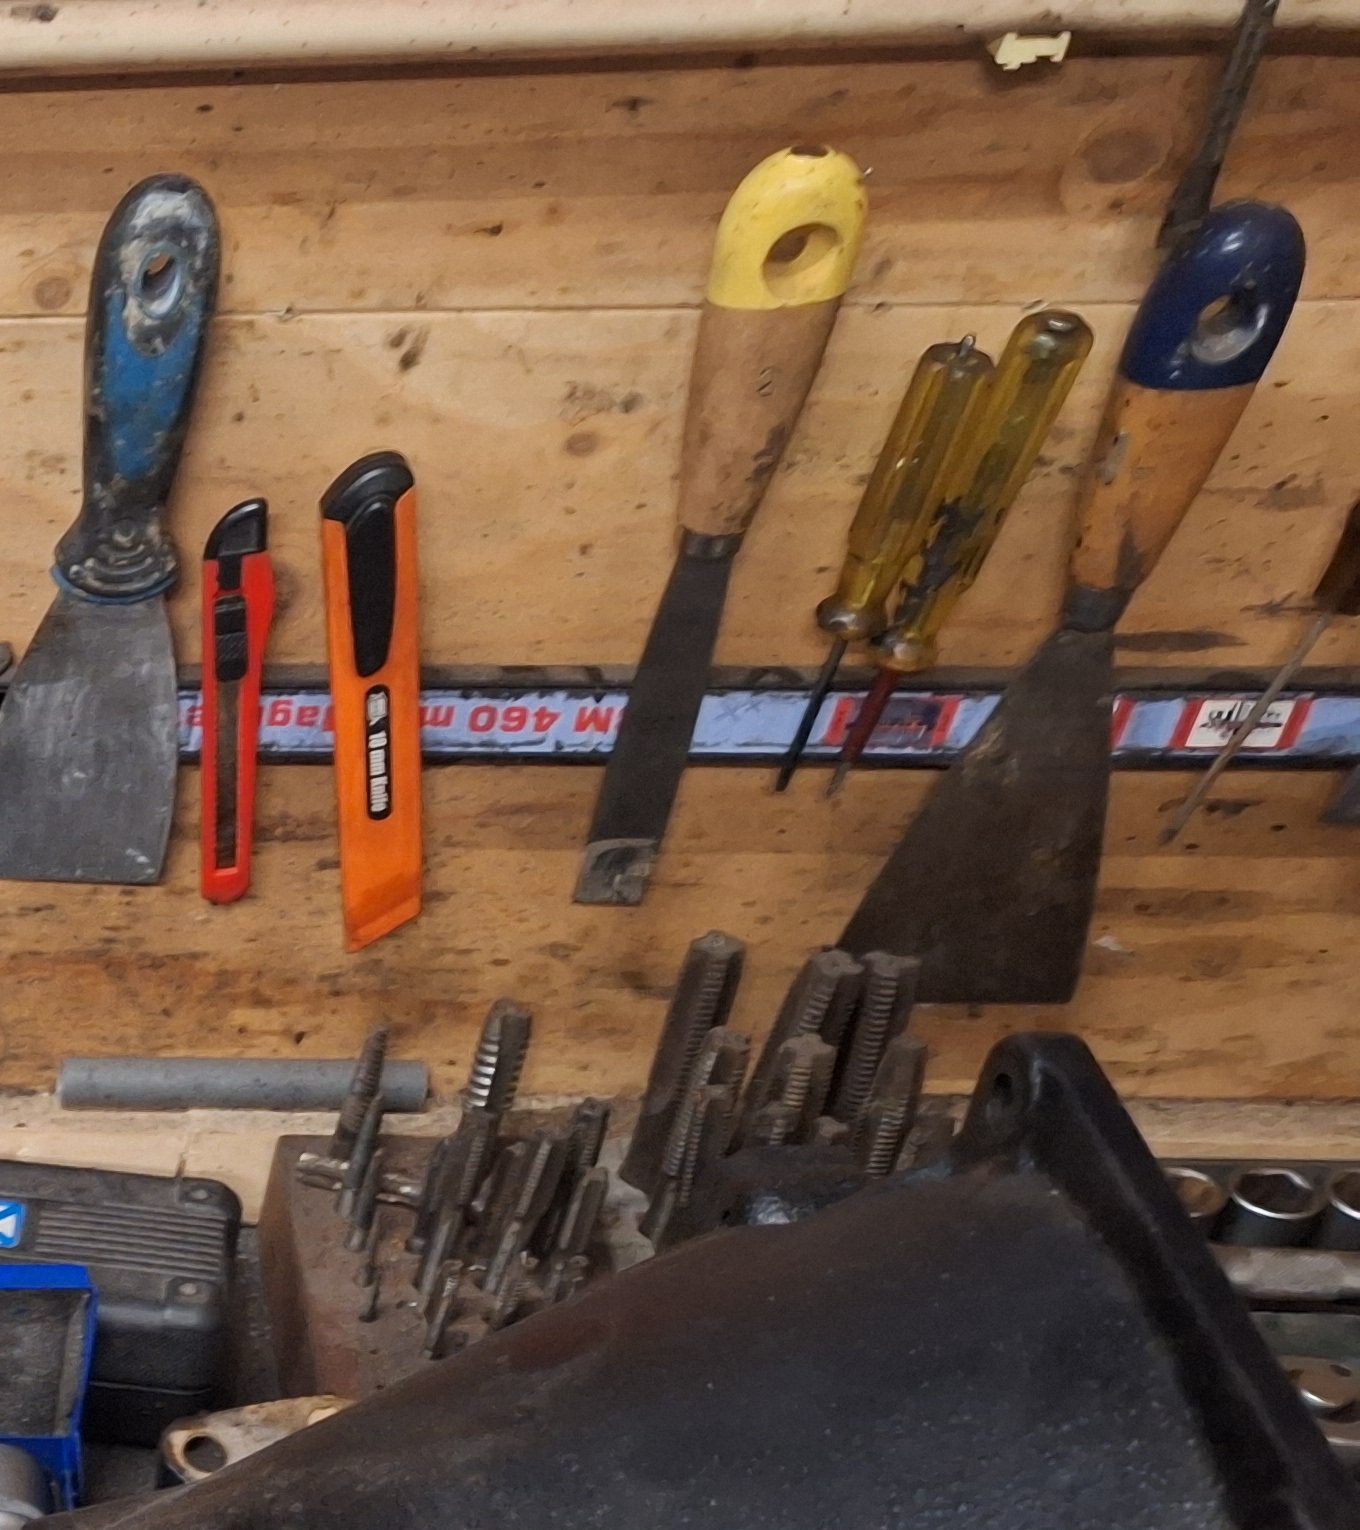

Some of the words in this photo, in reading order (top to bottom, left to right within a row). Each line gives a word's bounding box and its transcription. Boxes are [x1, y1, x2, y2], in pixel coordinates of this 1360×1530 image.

[467, 705, 561, 734] 460
[367, 730, 388, 749] 10
[368, 749, 387, 776] mm
